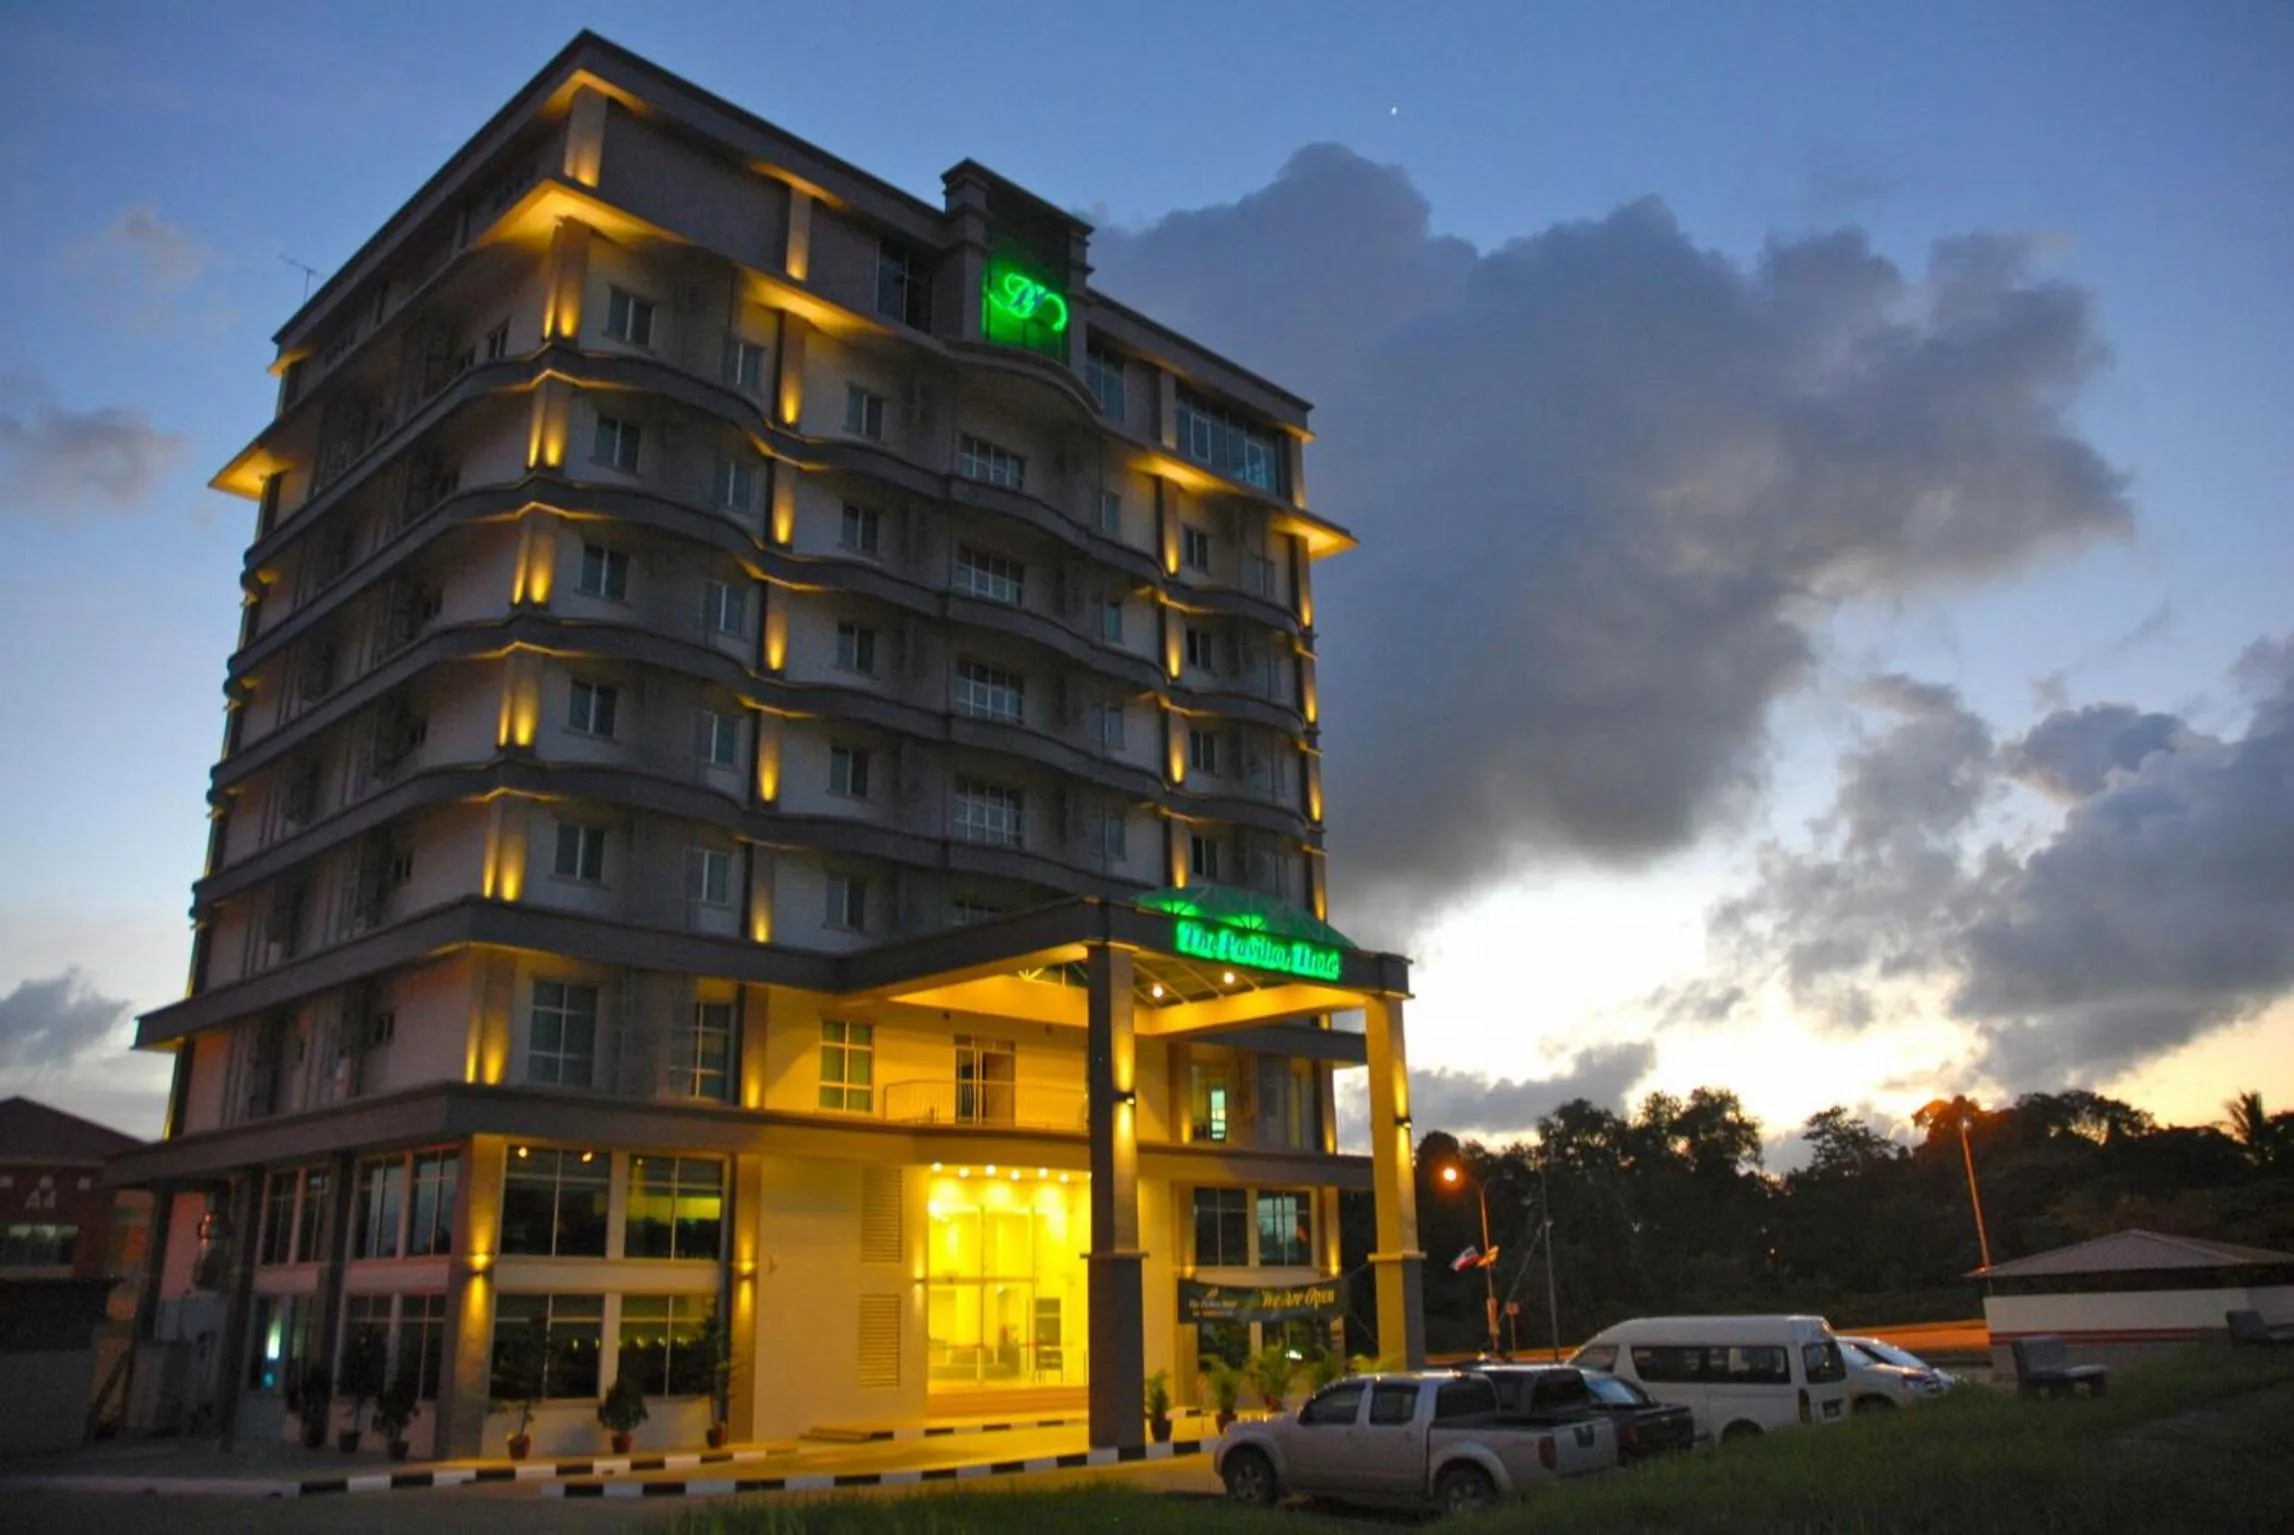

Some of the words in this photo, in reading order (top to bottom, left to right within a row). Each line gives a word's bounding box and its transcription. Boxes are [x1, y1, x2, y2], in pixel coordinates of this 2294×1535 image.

[1261, 1288, 1281, 1308] We
[1282, 1288, 1303, 1308] Are
[1304, 1287, 1335, 1309] Open
